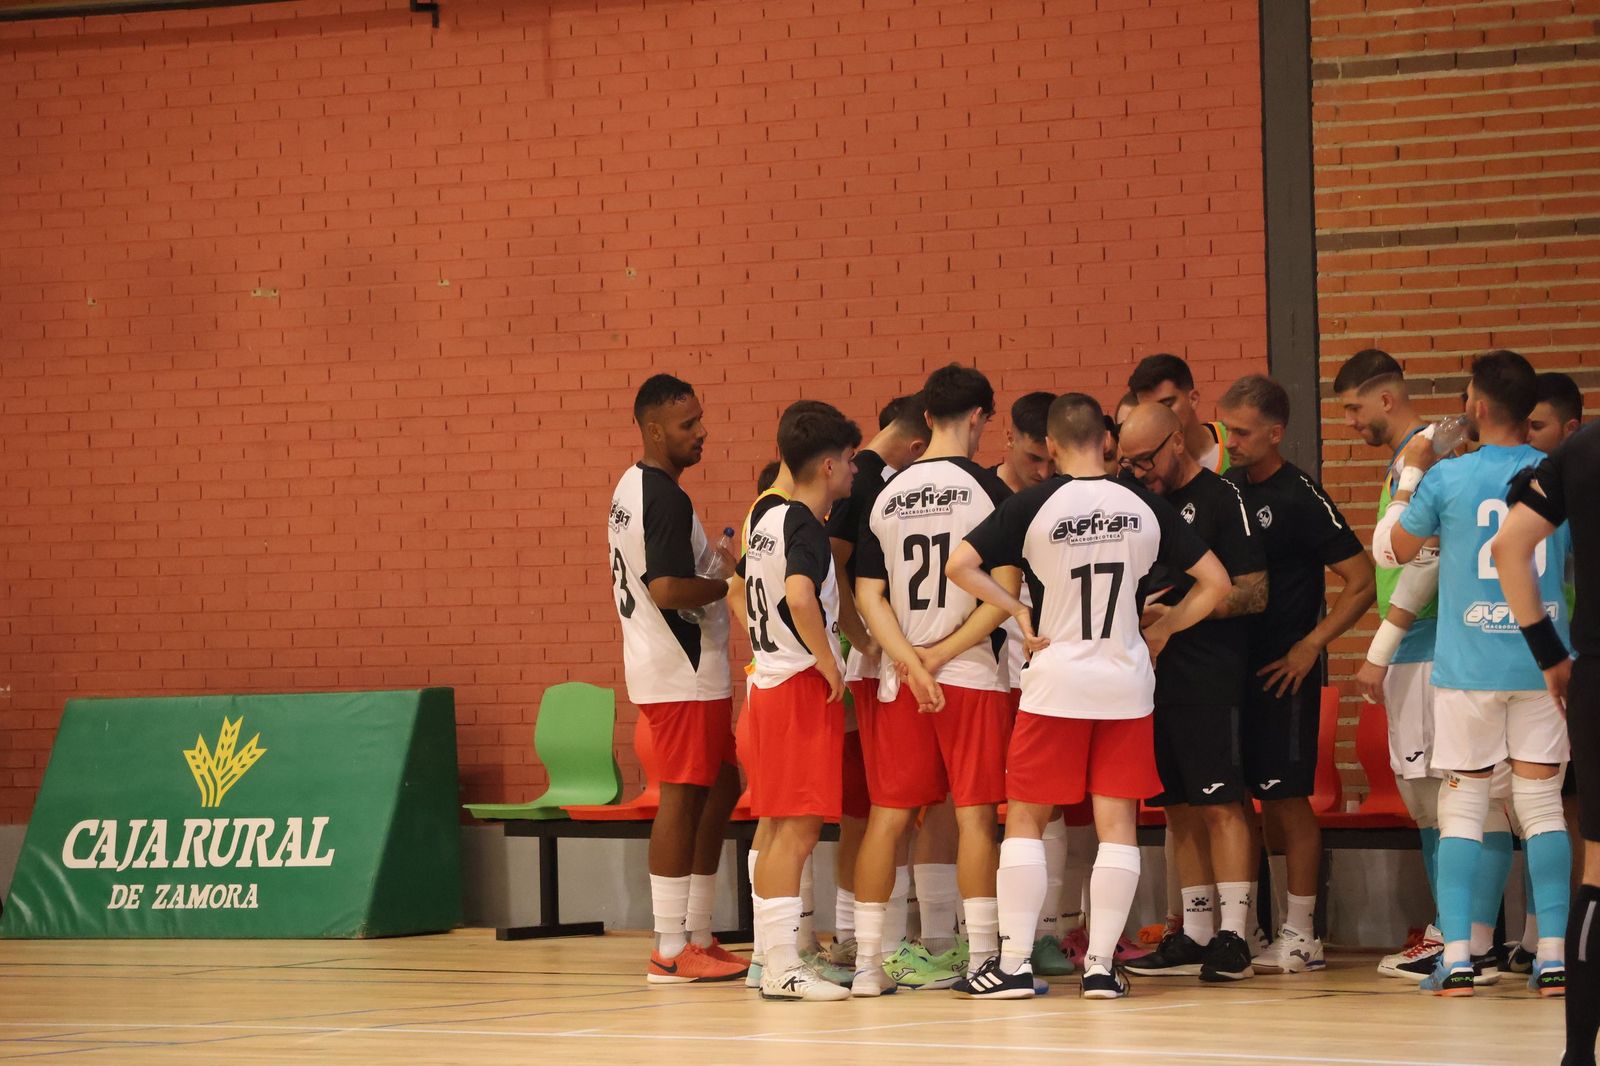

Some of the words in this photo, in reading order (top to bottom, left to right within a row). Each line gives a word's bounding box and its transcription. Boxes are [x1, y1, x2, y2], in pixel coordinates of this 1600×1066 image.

[903, 532, 950, 611] 21
[1070, 562, 1125, 641] 17
[62, 819, 170, 872] CAJA
[172, 816, 335, 868] RURAL
[107, 884, 144, 909] DE
[151, 883, 259, 909] ZAMORA
